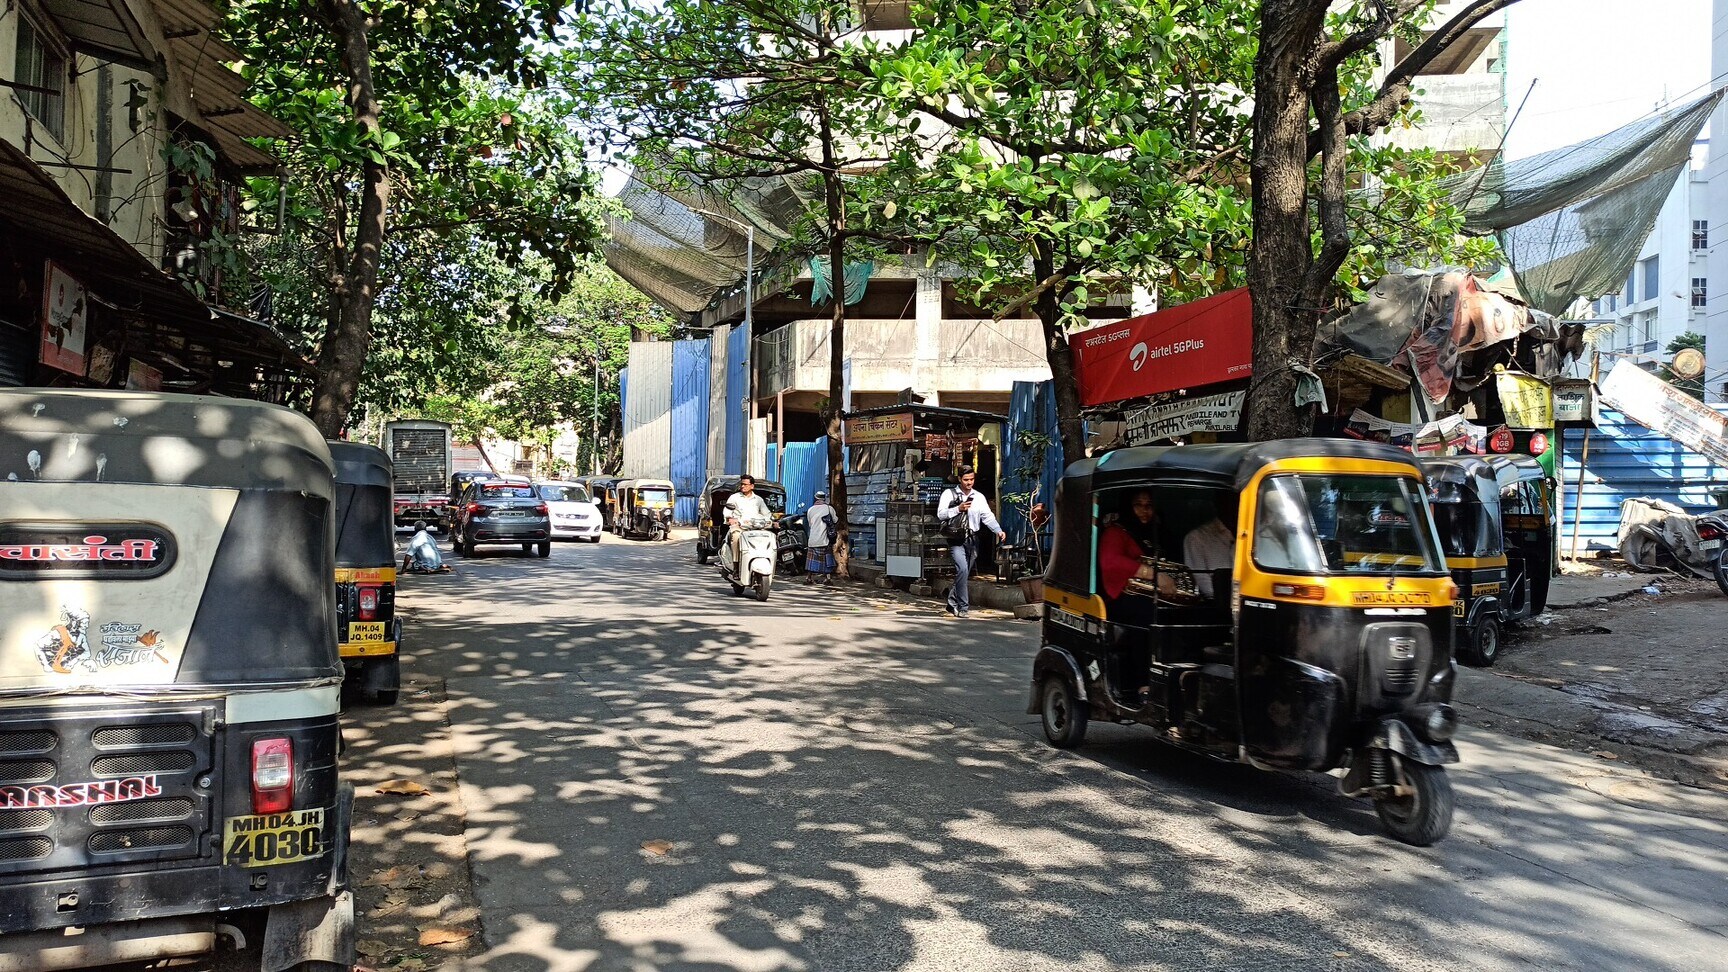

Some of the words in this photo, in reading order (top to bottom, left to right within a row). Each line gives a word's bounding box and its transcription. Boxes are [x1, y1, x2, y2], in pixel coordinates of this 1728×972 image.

[1150, 344, 1172, 359] airtel
[0, 774, 162, 809] ARSHAL
[232, 811, 320, 832] MH.04.JH
[226, 827, 321, 863] 4030
